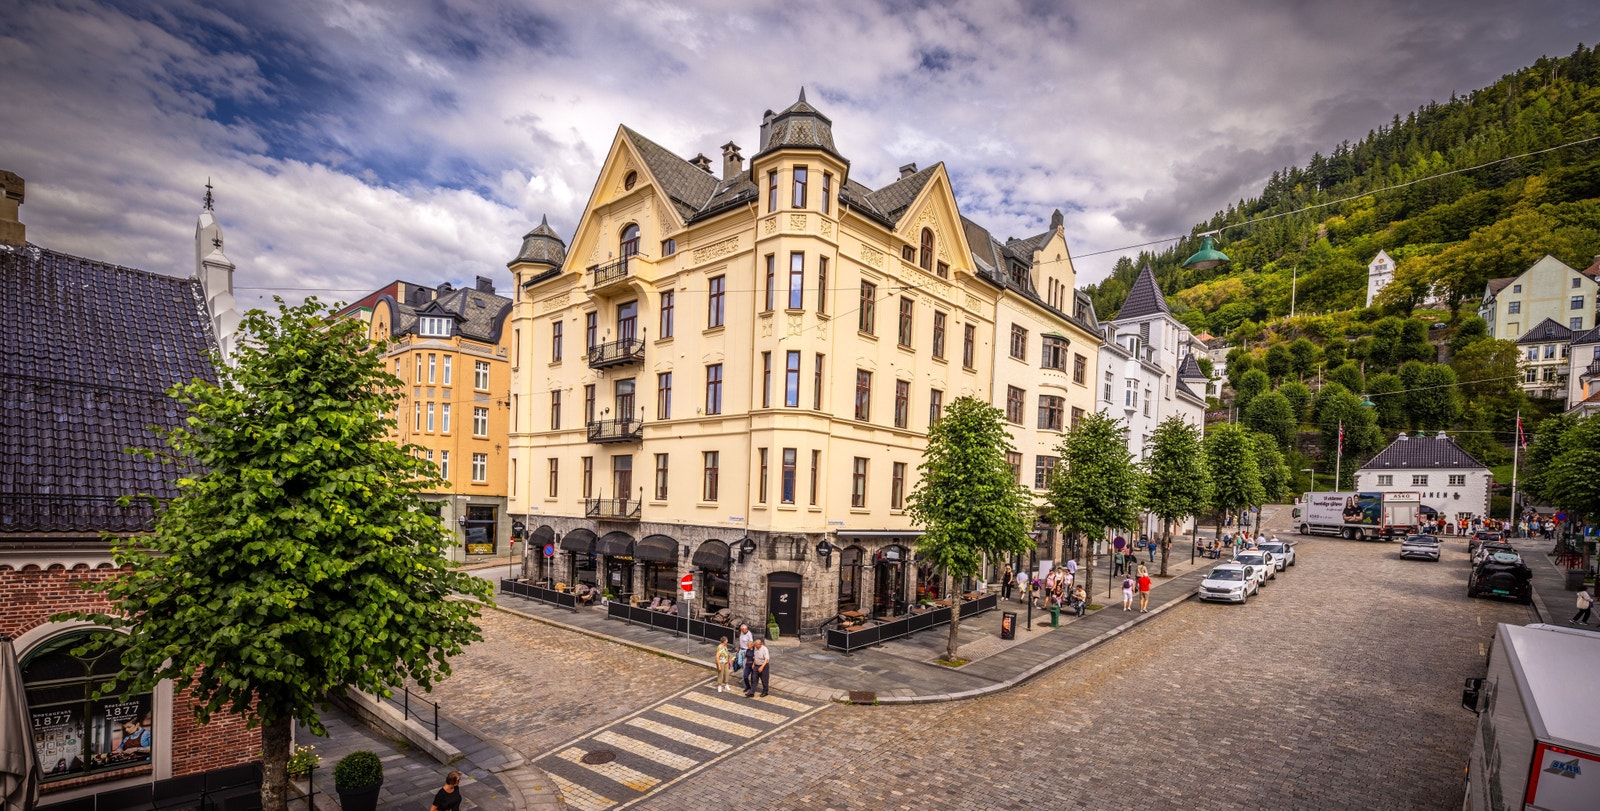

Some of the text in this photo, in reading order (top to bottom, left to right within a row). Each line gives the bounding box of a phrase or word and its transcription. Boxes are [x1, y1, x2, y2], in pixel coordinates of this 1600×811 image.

[1422, 491, 1448, 499] ANEN
[33, 710, 72, 718] Restaurant
[105, 705, 139, 717] 1877
[34, 714, 71, 727] 1877
